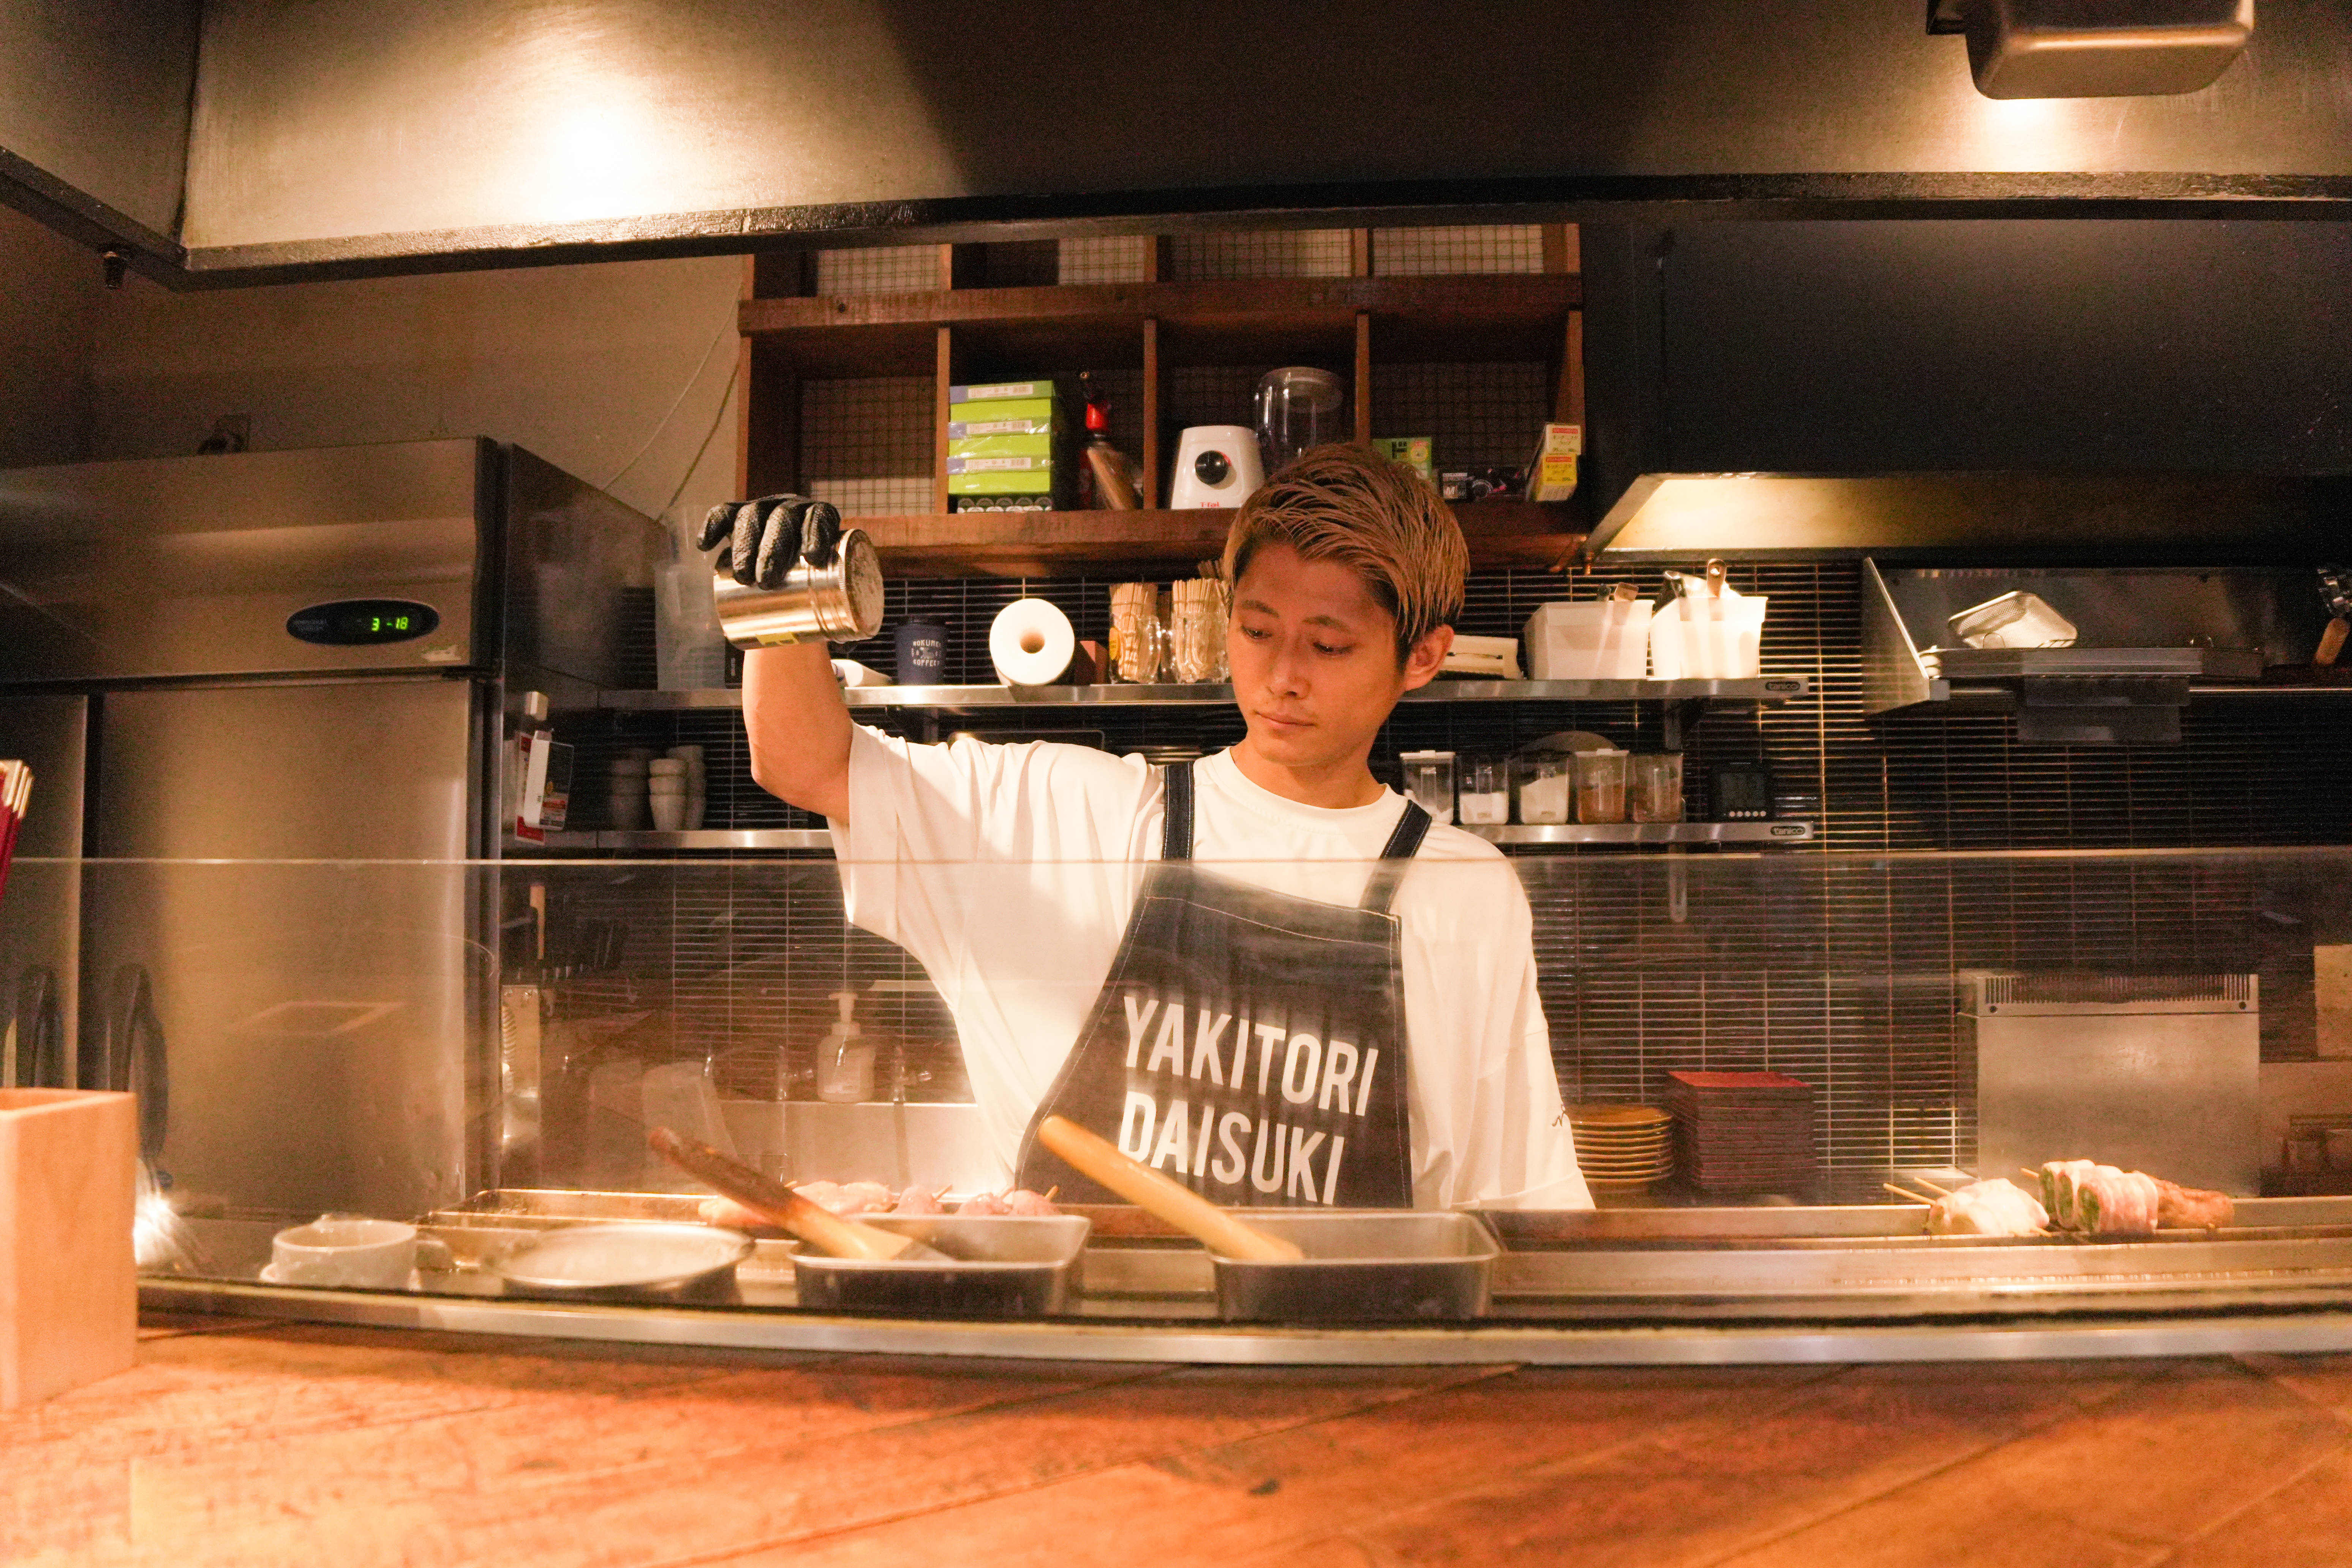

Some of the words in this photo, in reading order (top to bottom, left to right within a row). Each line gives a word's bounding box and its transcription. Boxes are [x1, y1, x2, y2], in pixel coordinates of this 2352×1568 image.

[372, 618, 380, 631] 3
[1124, 996, 1378, 1116] YAKITORI
[1118, 1091, 1344, 1205] DAISUKI
